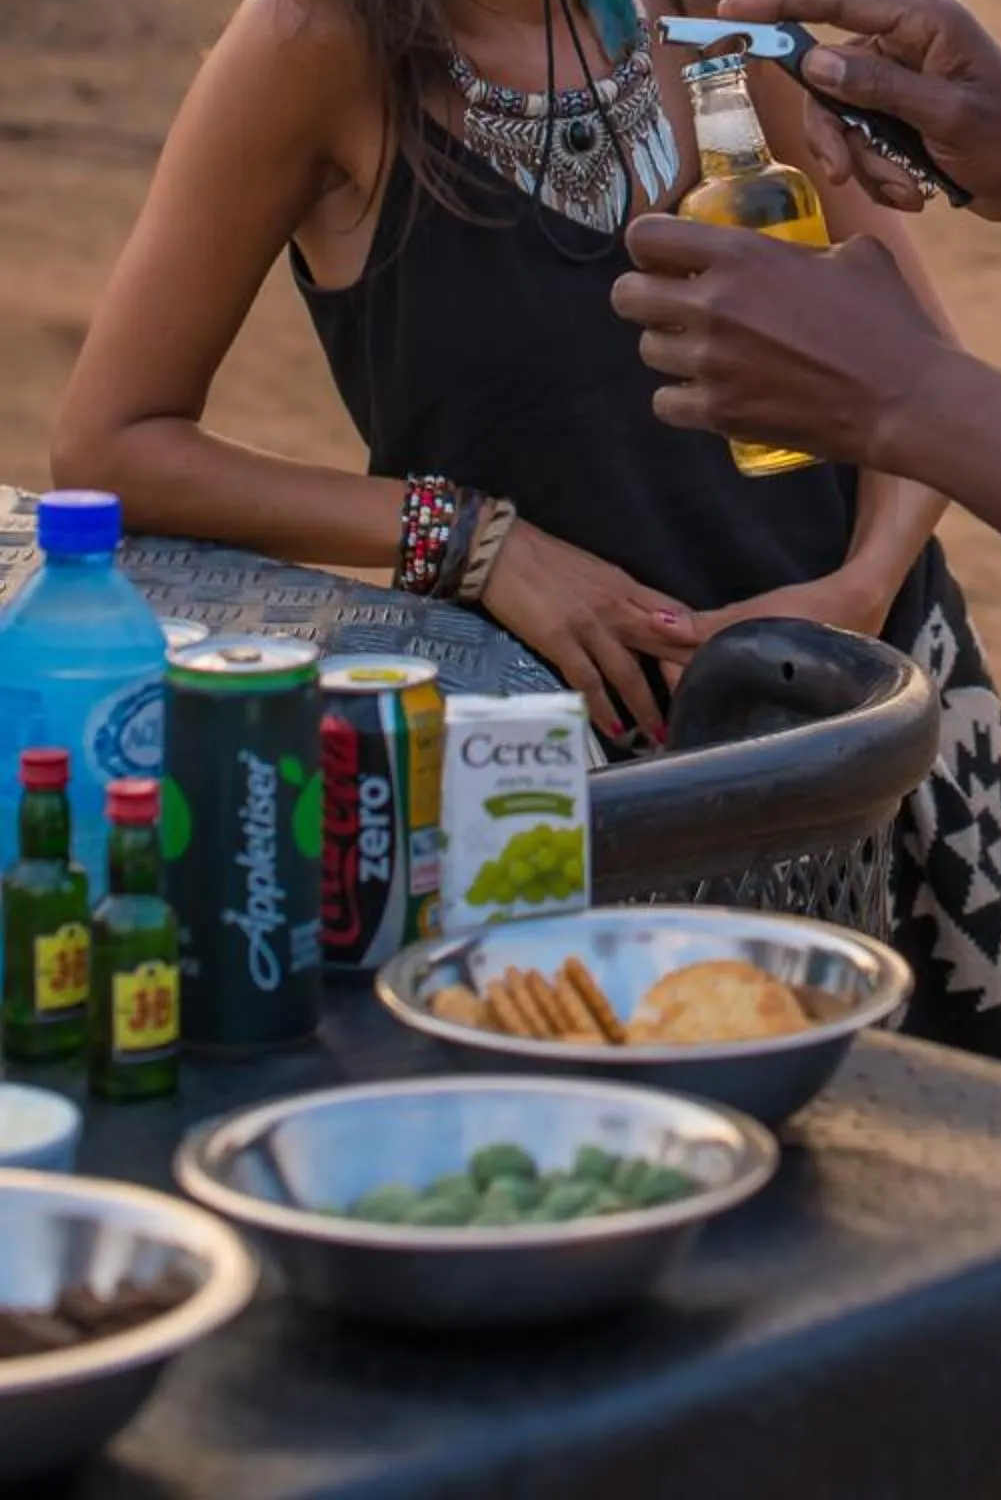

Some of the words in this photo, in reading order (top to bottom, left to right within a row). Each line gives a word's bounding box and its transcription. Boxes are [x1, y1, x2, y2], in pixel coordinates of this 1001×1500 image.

[461, 732, 573, 768] Ceres
[221, 750, 286, 990] Appletiser
[358, 775, 390, 882] zero
